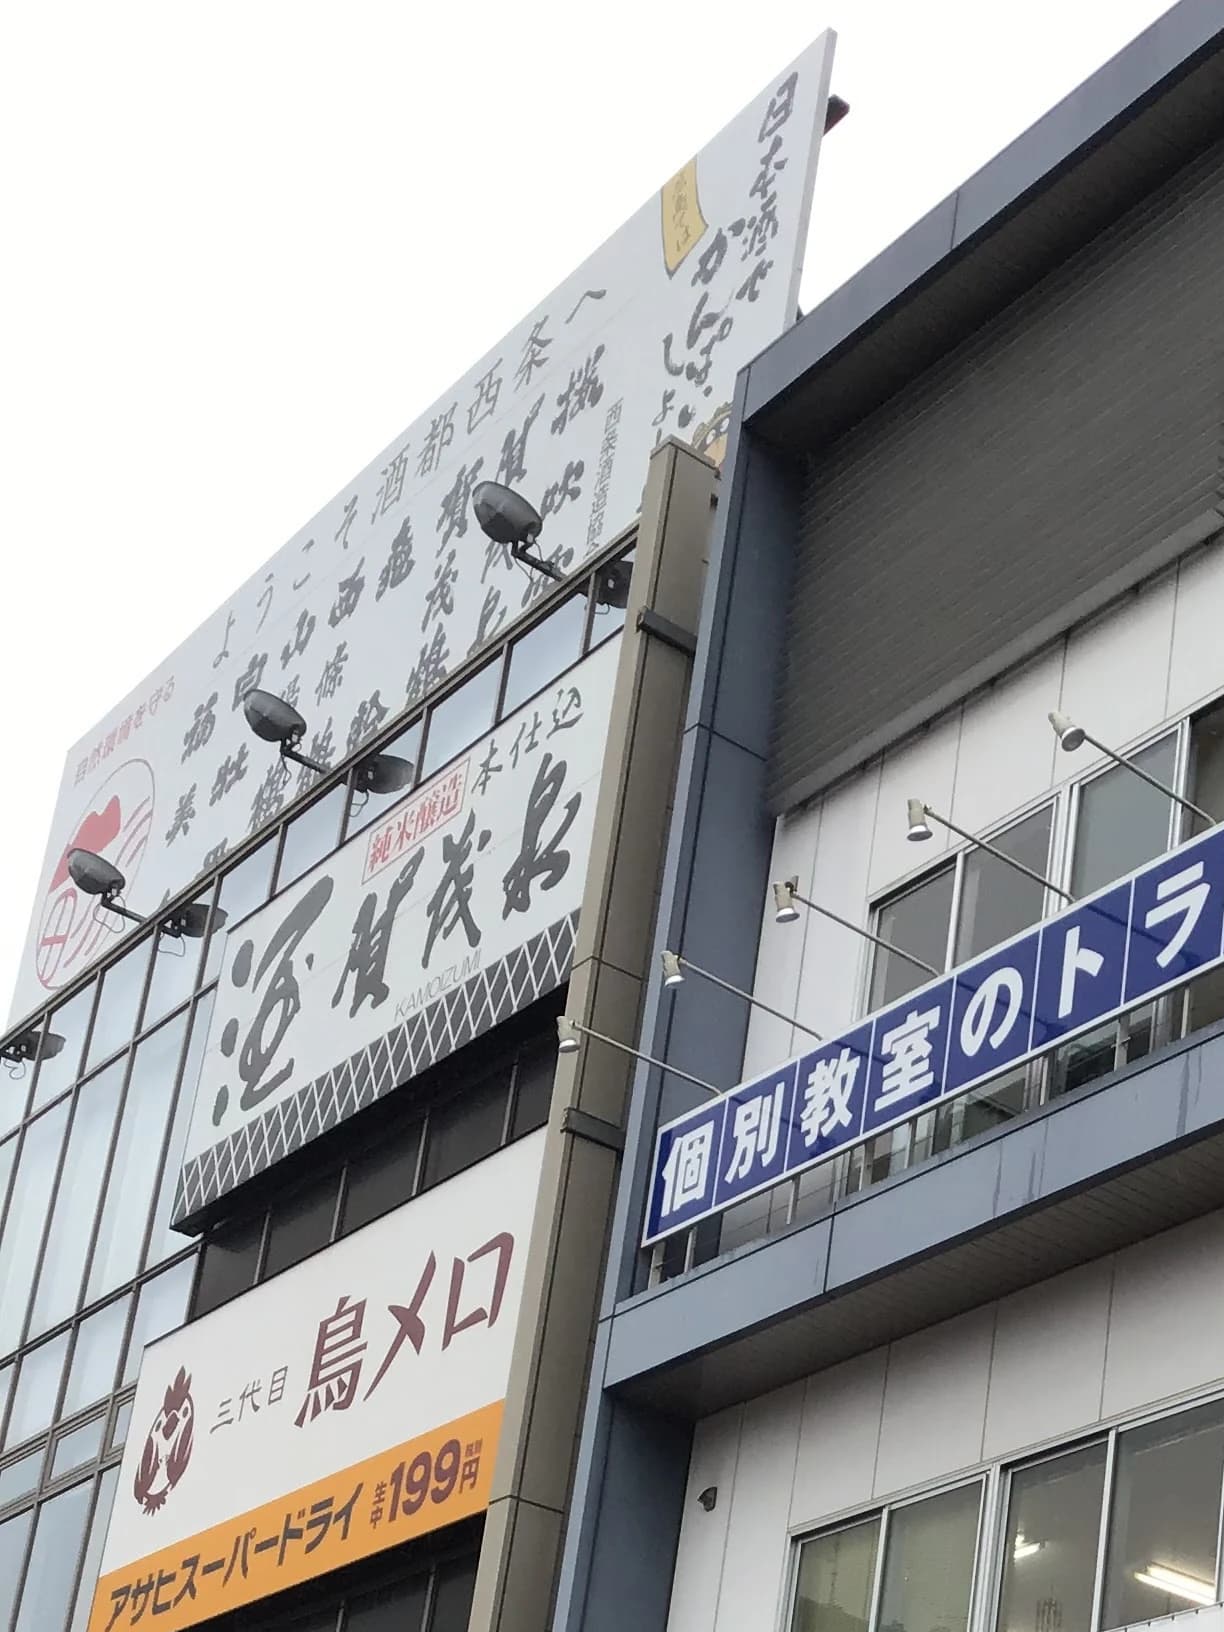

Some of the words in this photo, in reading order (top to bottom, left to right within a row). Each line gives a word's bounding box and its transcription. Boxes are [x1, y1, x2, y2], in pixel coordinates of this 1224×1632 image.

[736, 72, 798, 302] 日本酒で
[212, 288, 607, 669] ようこそ酒都西条へ
[471, 687, 584, 796] 本仕込
[210, 1366, 289, 1434] 三代目
